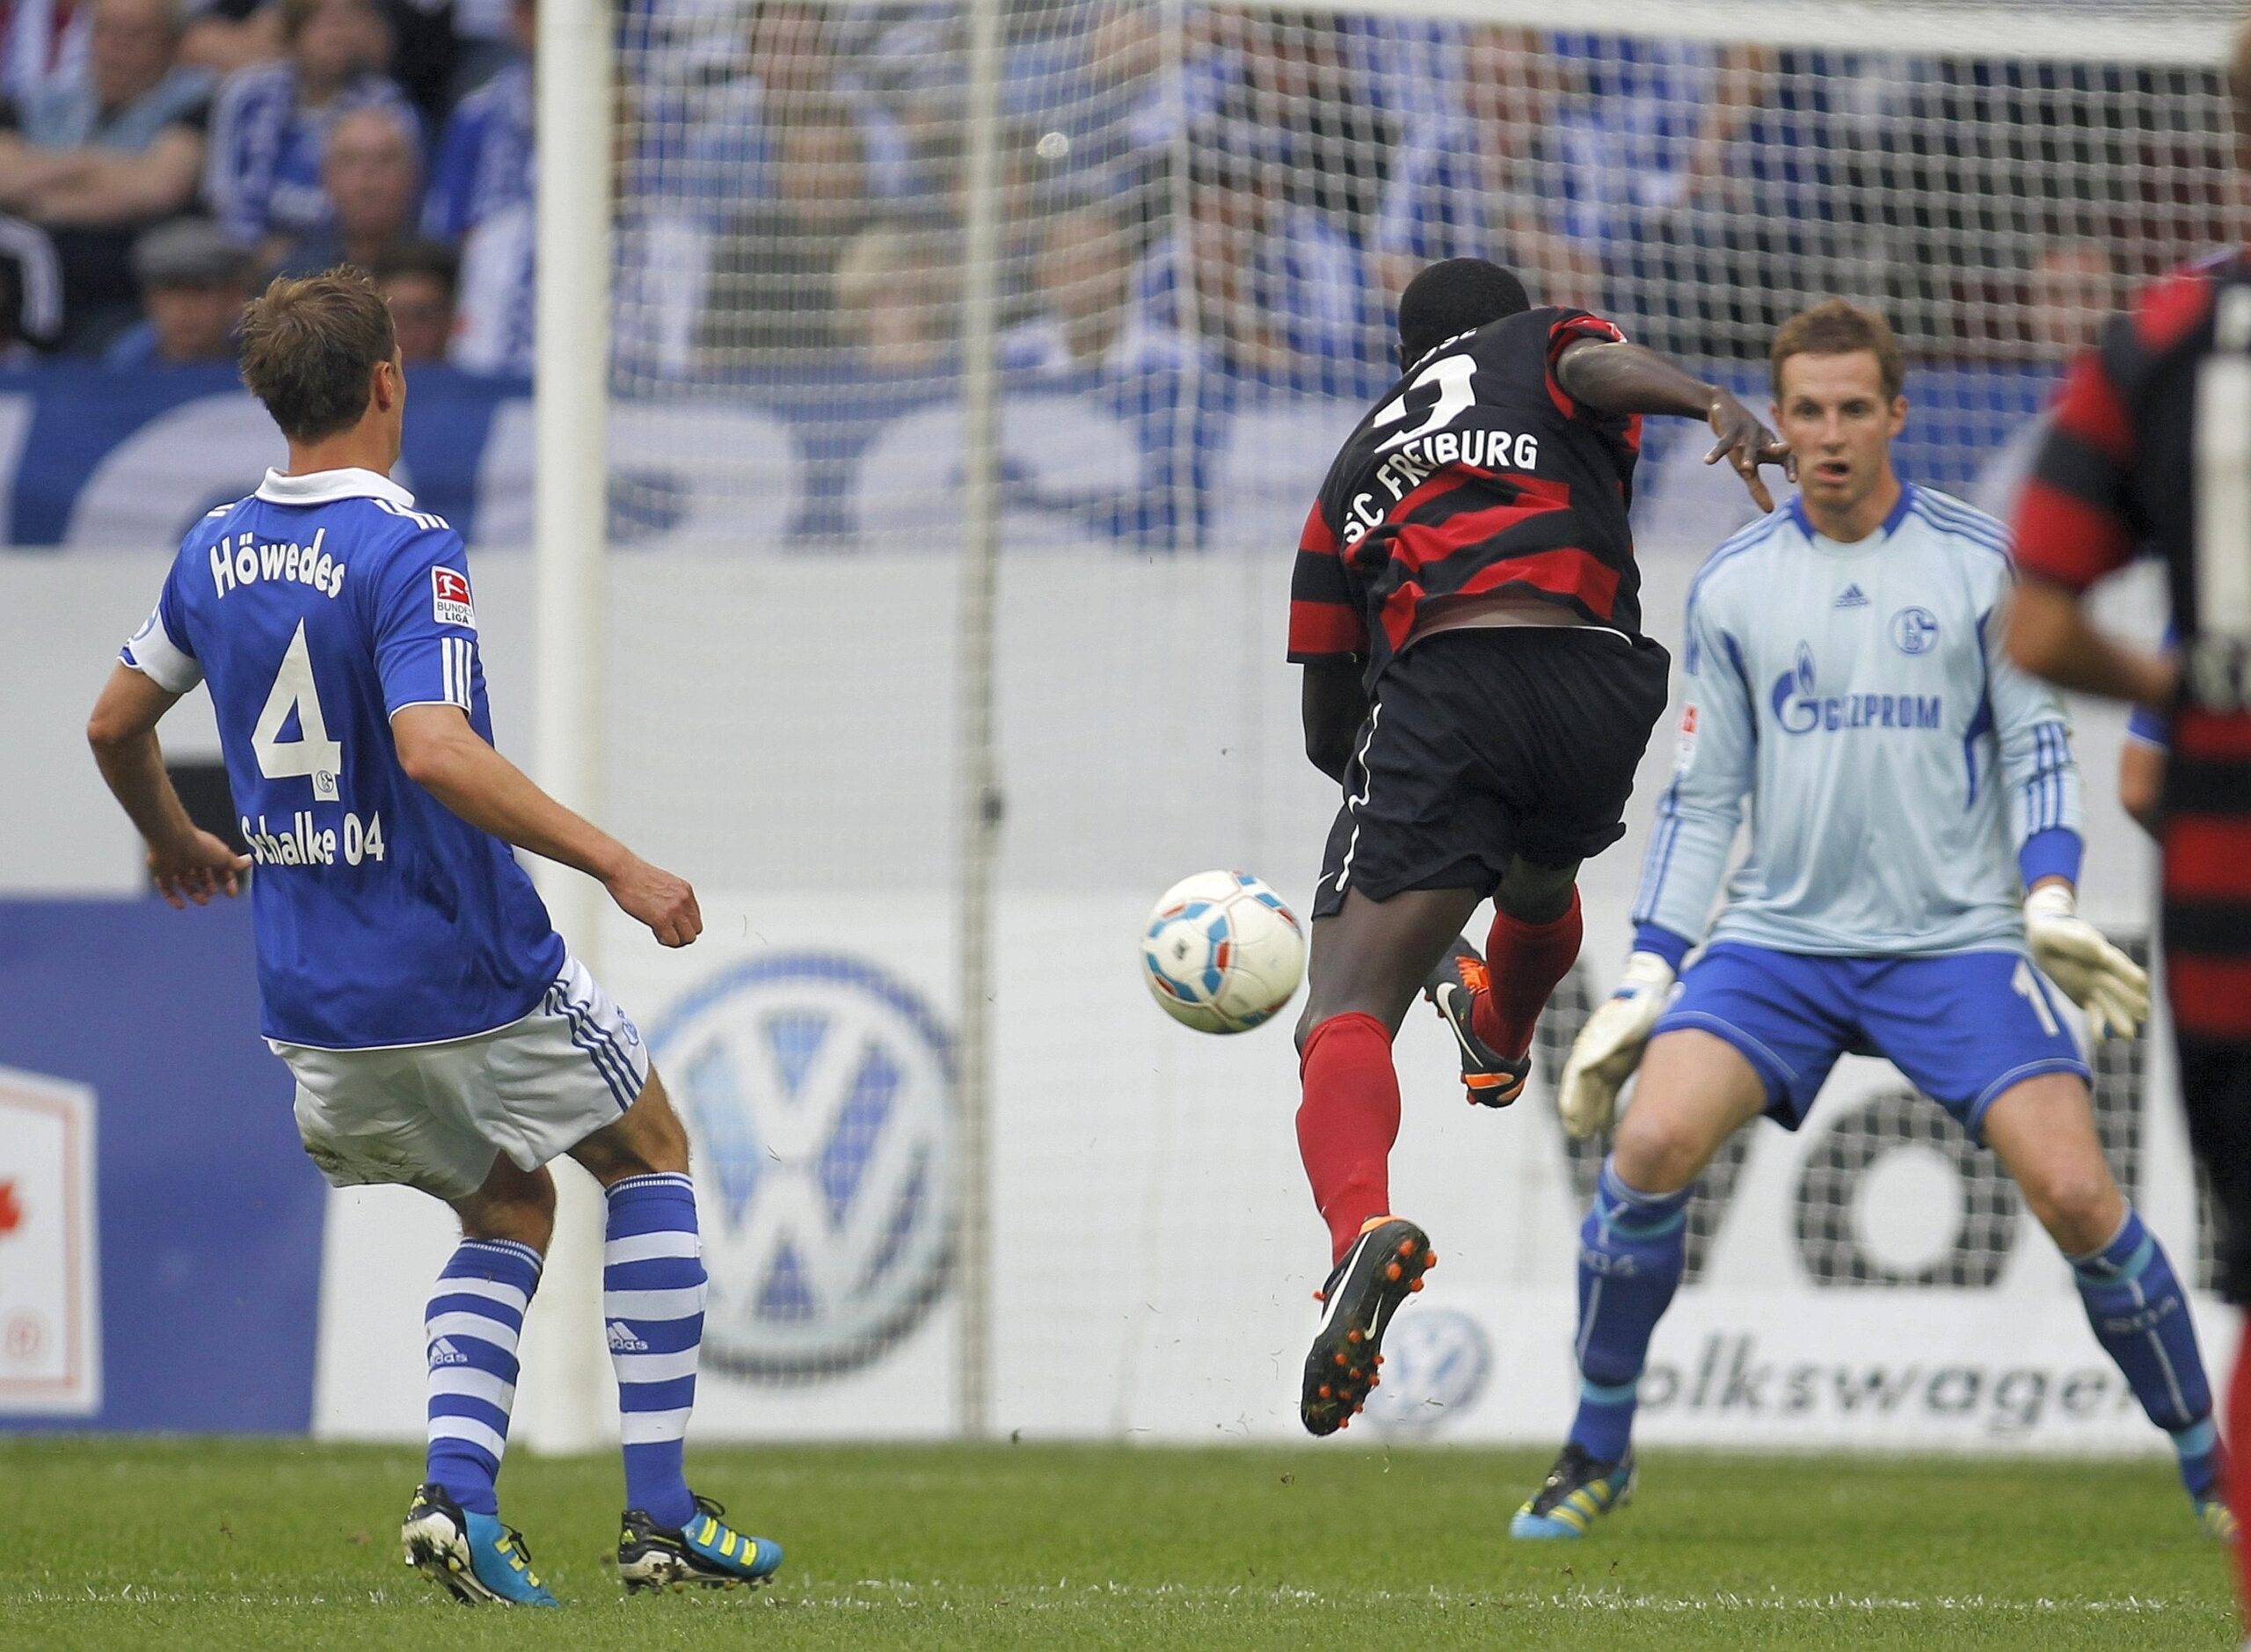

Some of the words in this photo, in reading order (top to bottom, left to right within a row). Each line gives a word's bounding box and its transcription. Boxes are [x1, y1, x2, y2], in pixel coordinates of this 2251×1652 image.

[1344, 492, 1385, 543] SC
[1376, 429, 1538, 501] FREIBURG
[210, 528, 346, 600] Höwedes
[445, 612, 469, 624] LIGA
[251, 615, 341, 802] 4
[241, 811, 337, 866] Schalke
[344, 811, 384, 866] 04
[2011, 957, 2059, 1037] 1
[1637, 1332, 2131, 1435] olkswage
